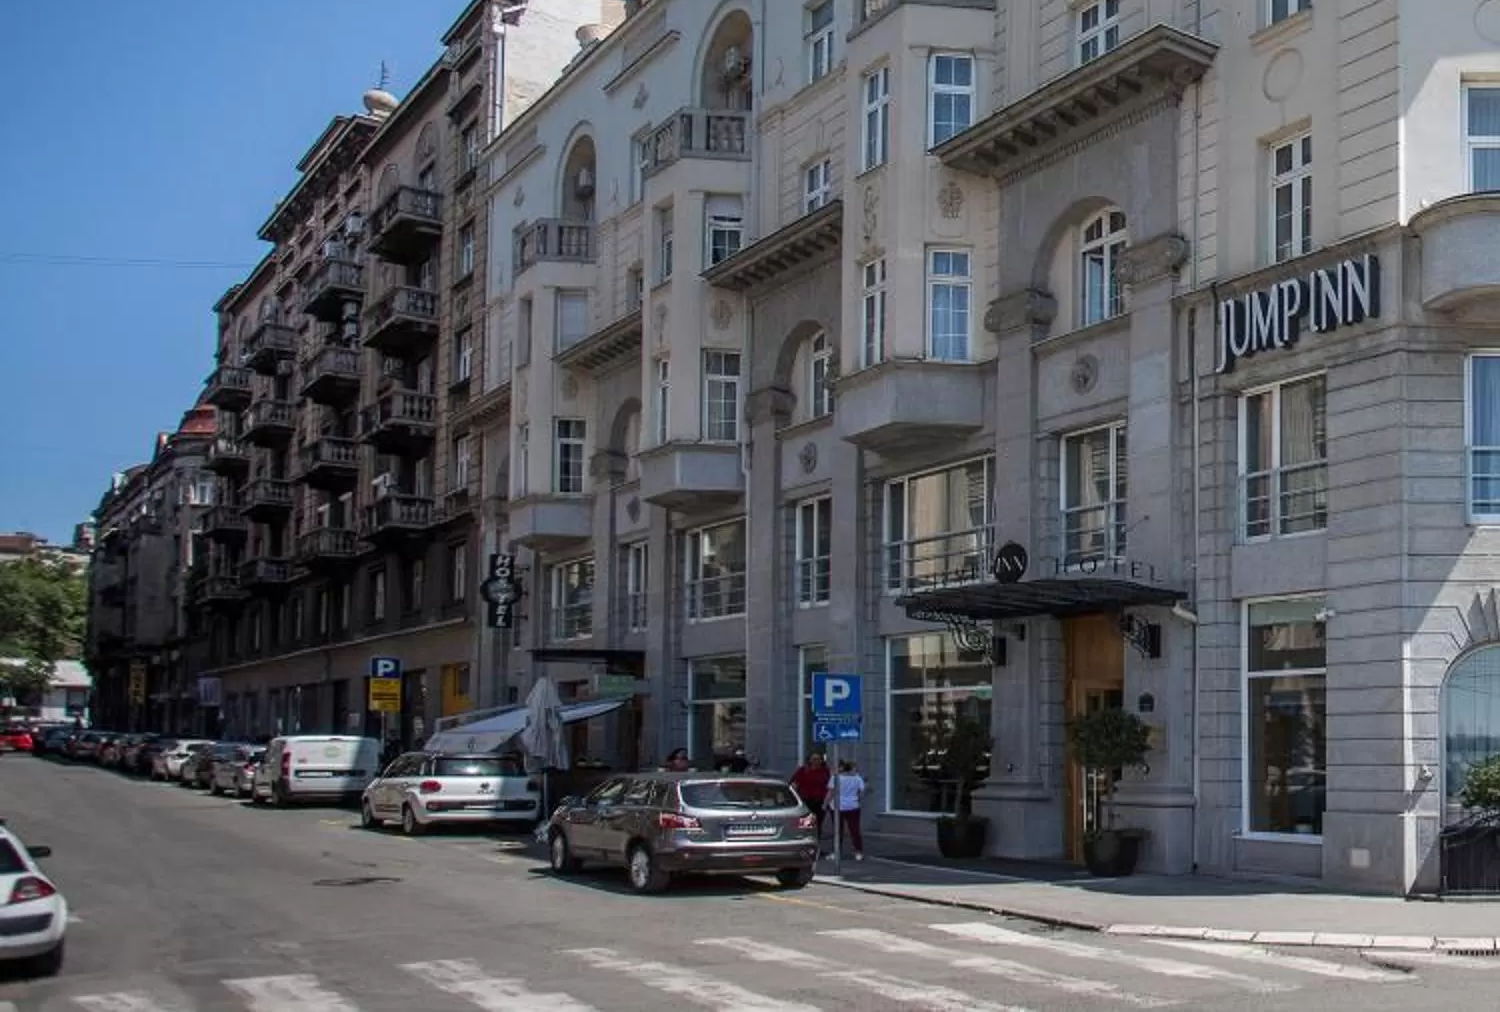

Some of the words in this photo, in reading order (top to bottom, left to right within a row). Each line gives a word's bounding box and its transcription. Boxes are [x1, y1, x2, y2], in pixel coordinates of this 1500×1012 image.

[1215, 278, 1301, 373] JUMP
[1309, 253, 1375, 333] INN
[377, 659, 395, 677] P
[825, 679, 851, 707] P
